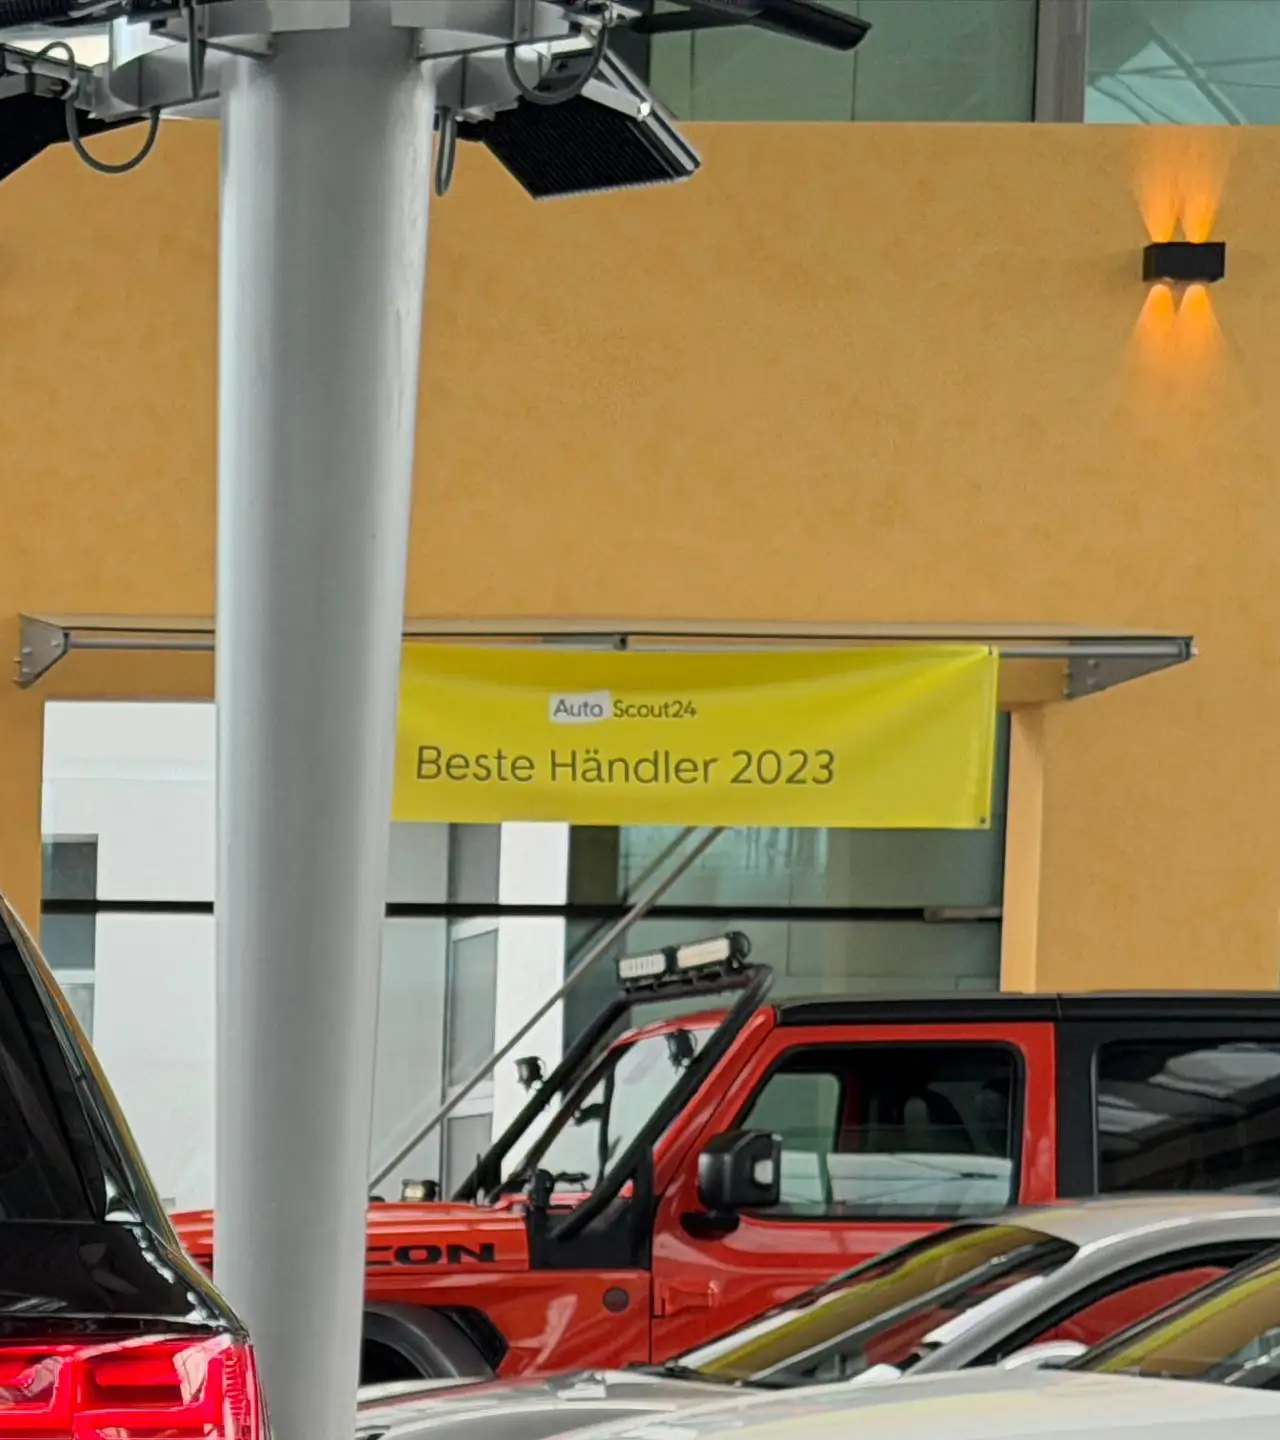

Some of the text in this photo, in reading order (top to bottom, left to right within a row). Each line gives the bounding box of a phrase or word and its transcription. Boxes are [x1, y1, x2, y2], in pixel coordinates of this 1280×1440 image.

[553, 699, 697, 719] Auto Scout24
[416, 746, 835, 785] Beste Händler 2023
